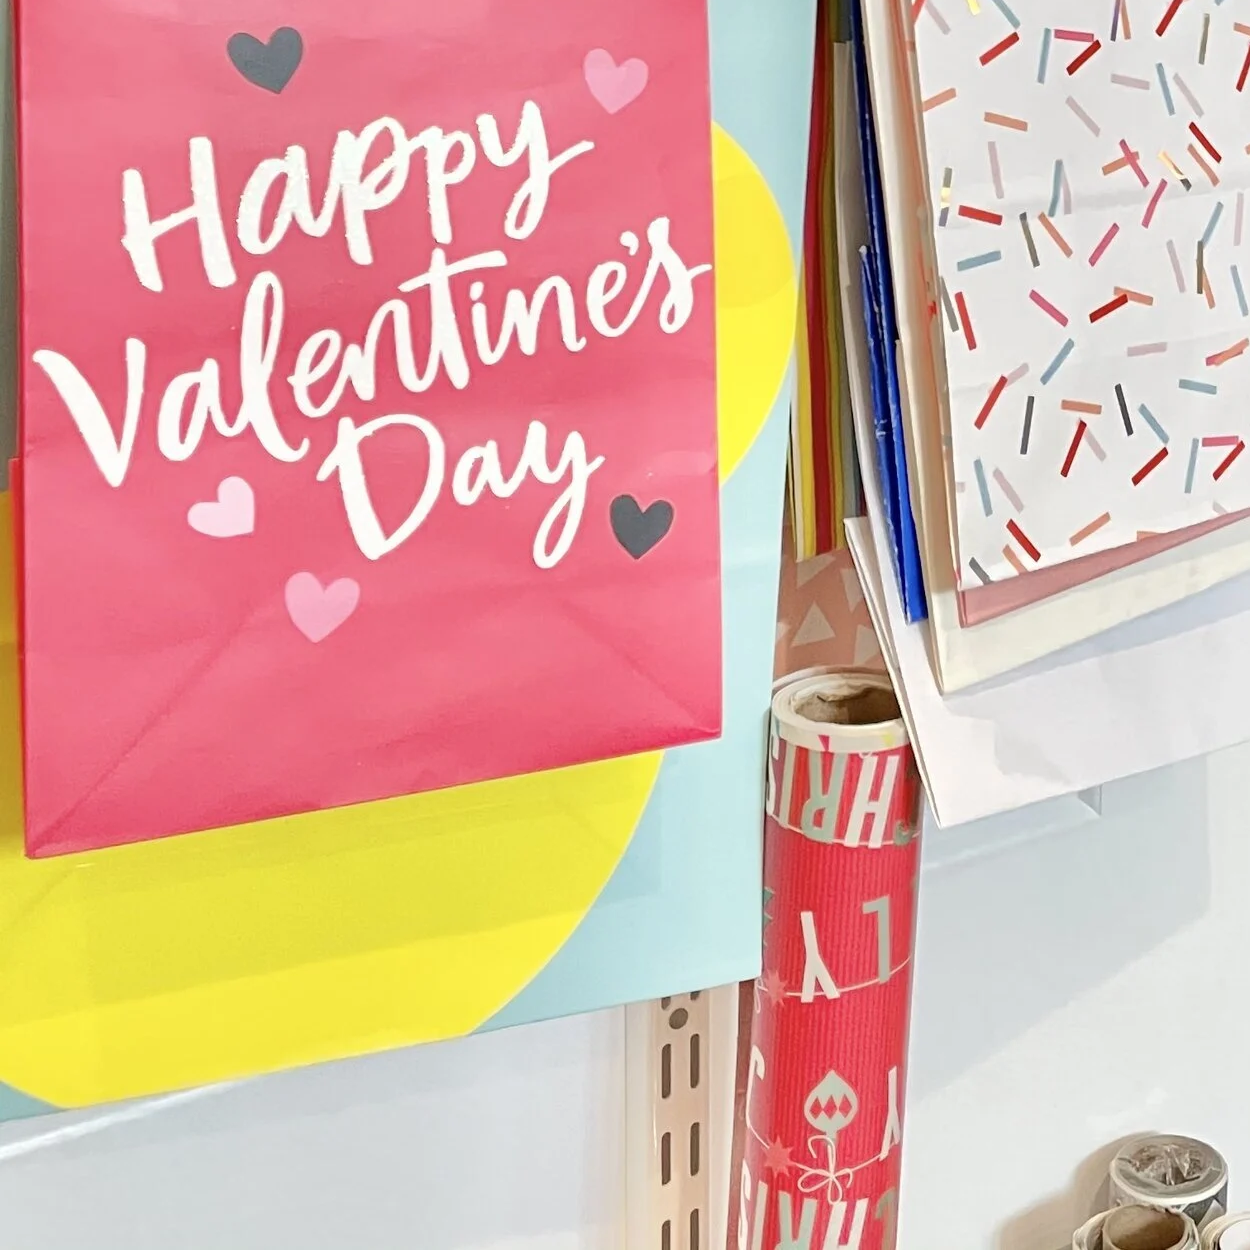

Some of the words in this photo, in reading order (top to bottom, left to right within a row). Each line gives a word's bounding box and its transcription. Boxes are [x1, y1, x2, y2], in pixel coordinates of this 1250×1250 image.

[121, 98, 595, 292] Happy
[32, 214, 714, 488] Valentine's
[315, 412, 605, 569] Day
